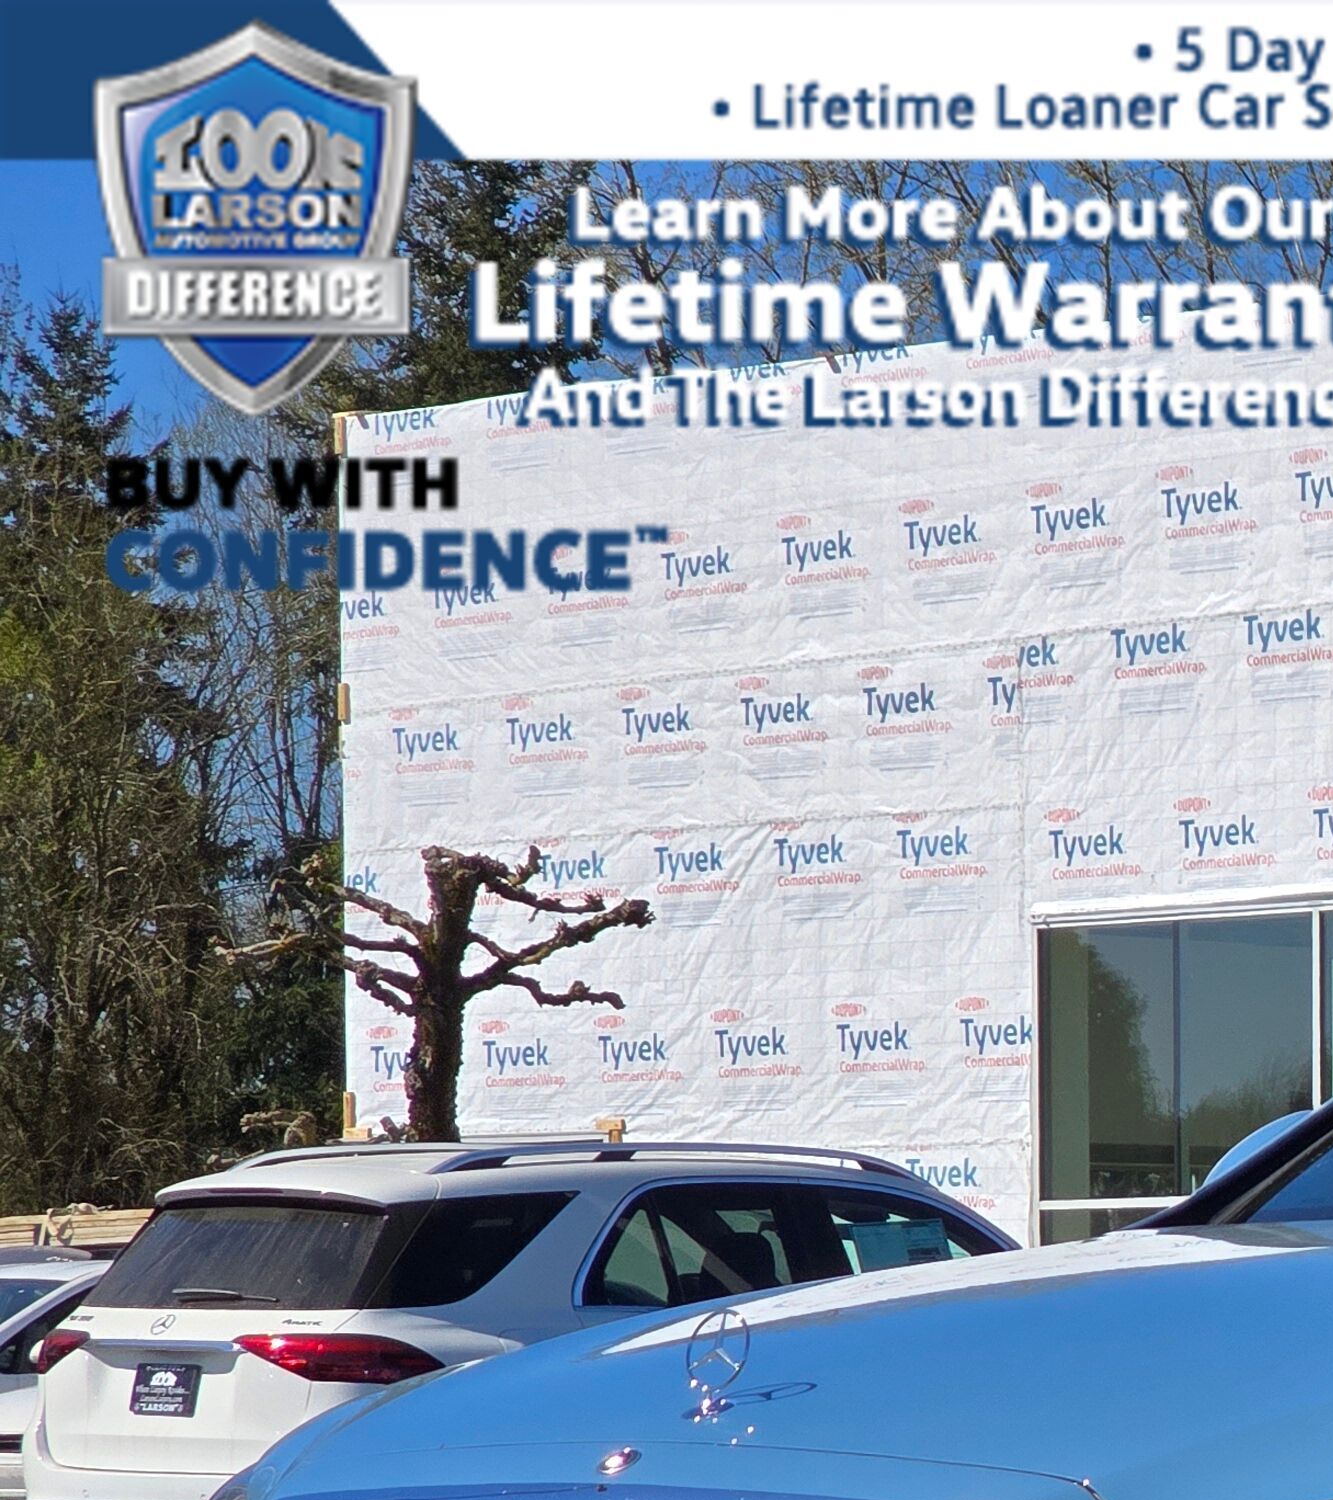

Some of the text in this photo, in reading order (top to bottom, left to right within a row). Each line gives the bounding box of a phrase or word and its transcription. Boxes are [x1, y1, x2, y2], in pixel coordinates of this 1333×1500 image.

[1033, 499, 1108, 539] Tyvek
[1164, 483, 1240, 524] Tyvek
[785, 531, 854, 569] Tyvek
[906, 515, 977, 555] Tyvek
[665, 550, 733, 586] Tyvek
[1115, 627, 1187, 664] Tyvek
[1247, 612, 1322, 652] Tyvek
[1115, 662, 1205, 680] CommercialWrap
[625, 704, 691, 739] Tyvek
[745, 696, 812, 732] Tyvek
[867, 686, 937, 721] Tyvek
[395, 726, 460, 759] Tyvek
[509, 717, 574, 750] Tyvek
[778, 838, 845, 871] Tyvek
[901, 828, 969, 864] Tyvek
[1051, 826, 1126, 864] Tyvek
[1182, 818, 1256, 855] Tyvek
[658, 846, 724, 878] Tyvek
[488, 1040, 551, 1072] Tyvek
[602, 1034, 668, 1067] Tyvek
[718, 1028, 788, 1064] Tyvek
[841, 1023, 911, 1057] Tyvek
